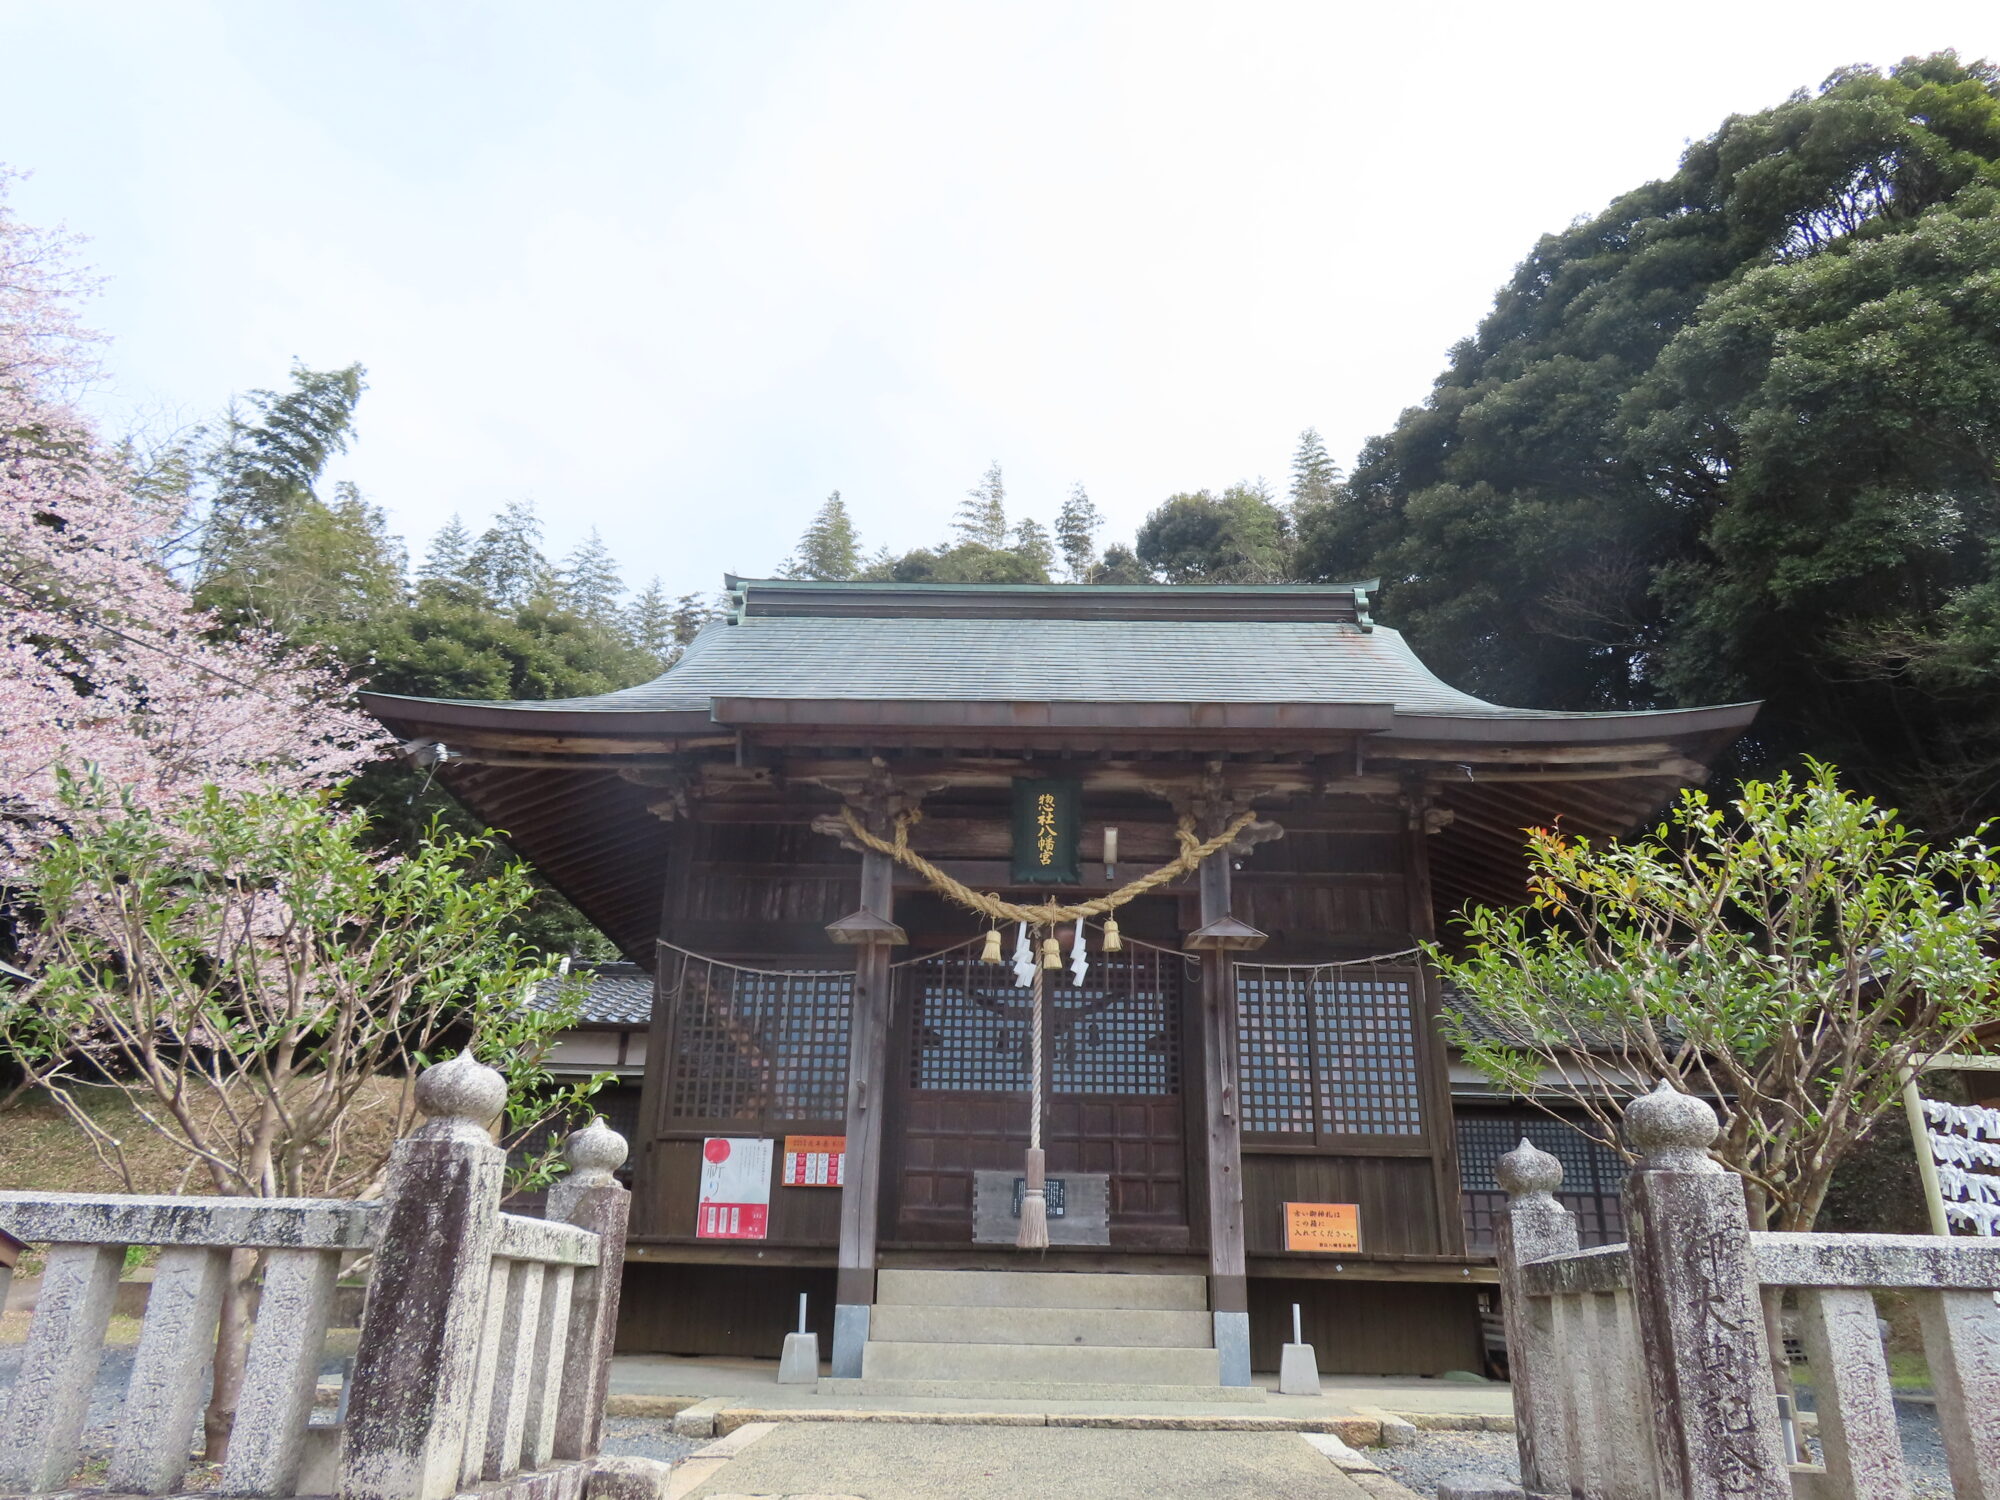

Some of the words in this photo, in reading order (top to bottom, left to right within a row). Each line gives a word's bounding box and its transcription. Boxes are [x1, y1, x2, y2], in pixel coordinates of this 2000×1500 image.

[1036, 793, 1058, 866] 惣社八幡宮
[1294, 1230, 1354, 1238] 入れてください。
